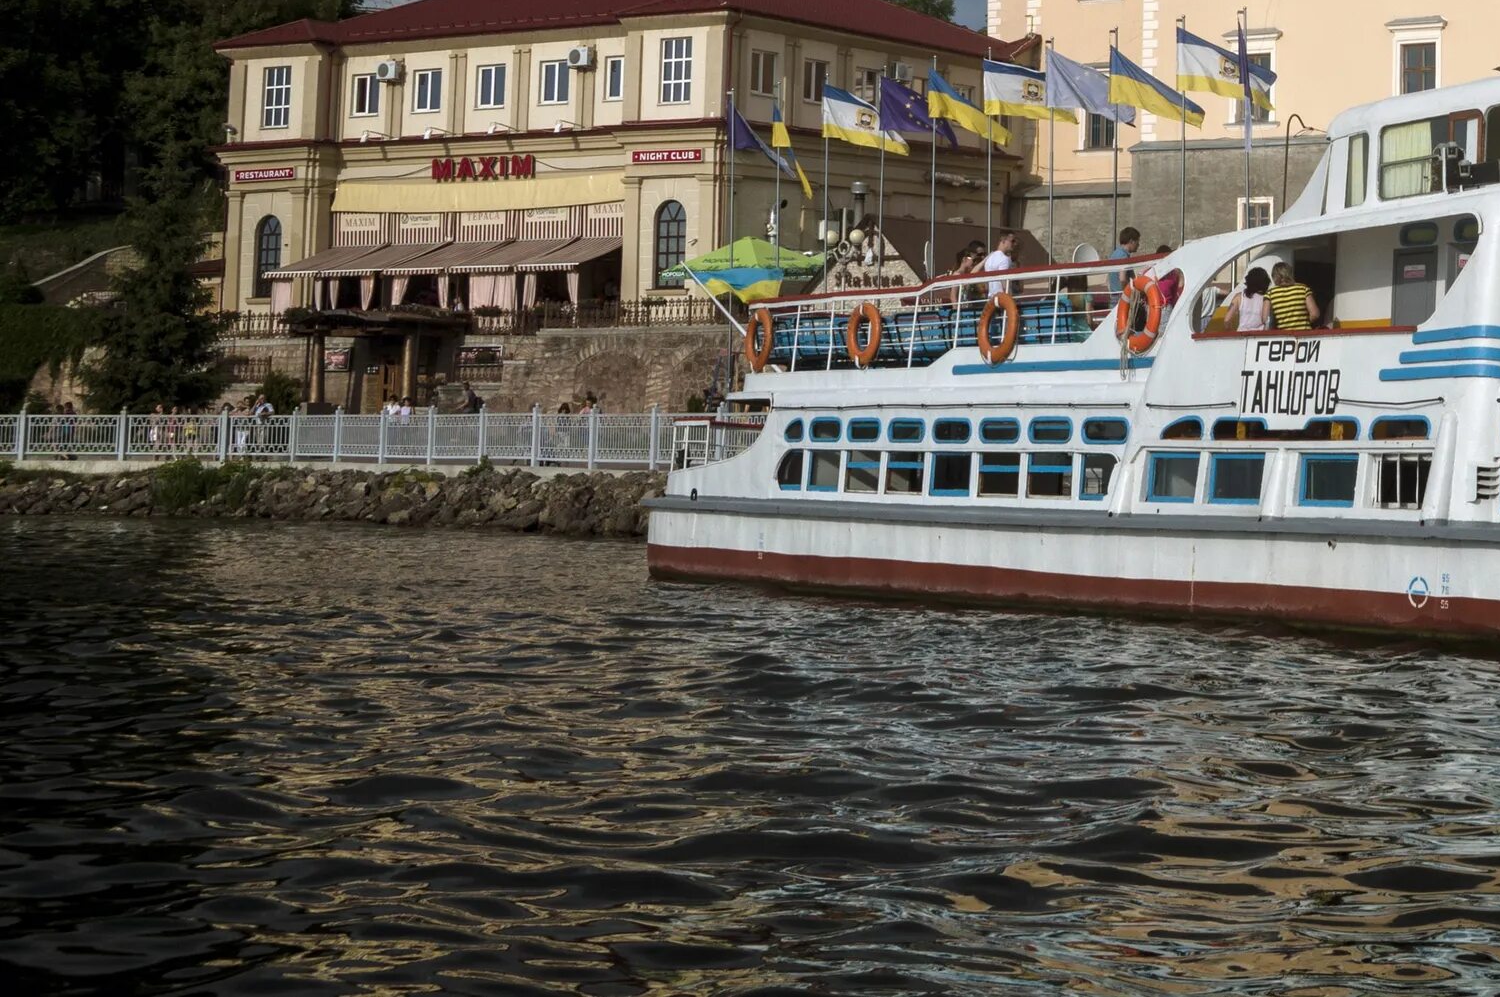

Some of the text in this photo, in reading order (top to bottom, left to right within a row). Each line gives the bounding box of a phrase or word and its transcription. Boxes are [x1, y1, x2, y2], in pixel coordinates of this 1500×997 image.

[639, 150, 695, 161] NIGHT CLUB
[432, 154, 536, 181] MAXIM
[239, 169, 291, 180] RESTAURANT
[345, 217, 376, 227] MAXIM
[1241, 369, 1341, 416] ТАНЦОРОВ
